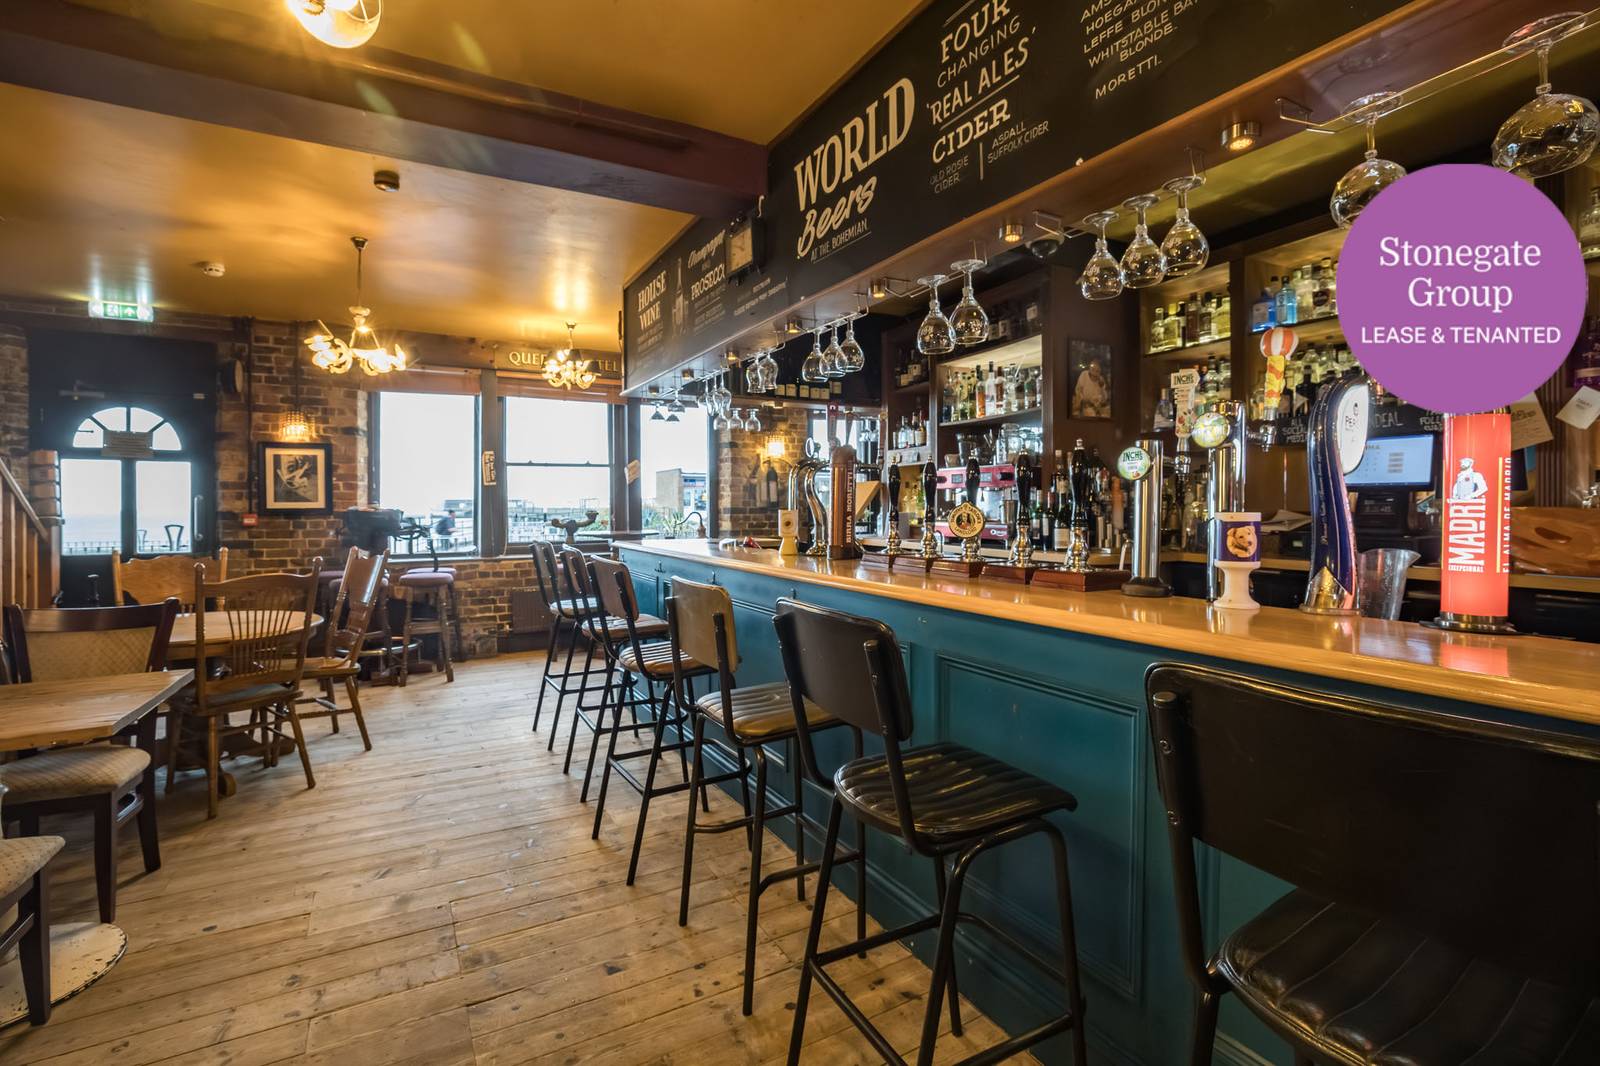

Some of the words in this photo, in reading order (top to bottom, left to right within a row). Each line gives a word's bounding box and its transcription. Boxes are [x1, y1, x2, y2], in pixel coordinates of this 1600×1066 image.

[941, 0, 1010, 64] FOUR
[1084, 20, 1123, 53] LEFFE
[1086, 0, 1137, 35] HOEGA
[1088, 9, 1170, 68] WHITSTABLE
[1173, 0, 1199, 16] BA
[937, 15, 1020, 88] CHANGING
[794, 77, 916, 212] WORLD
[932, 98, 1011, 164] CIDER
[987, 135, 1023, 164] SUFFOLK
[1024, 120, 1049, 143] CIDER
[934, 172, 961, 193] CIDER
[797, 176, 877, 257] Beers
[810, 248, 818, 262] AT
[819, 240, 830, 256] THE
[831, 219, 868, 249] BOHEMIAN
[638, 270, 667, 312] HOUSE
[640, 301, 661, 330] WINE
